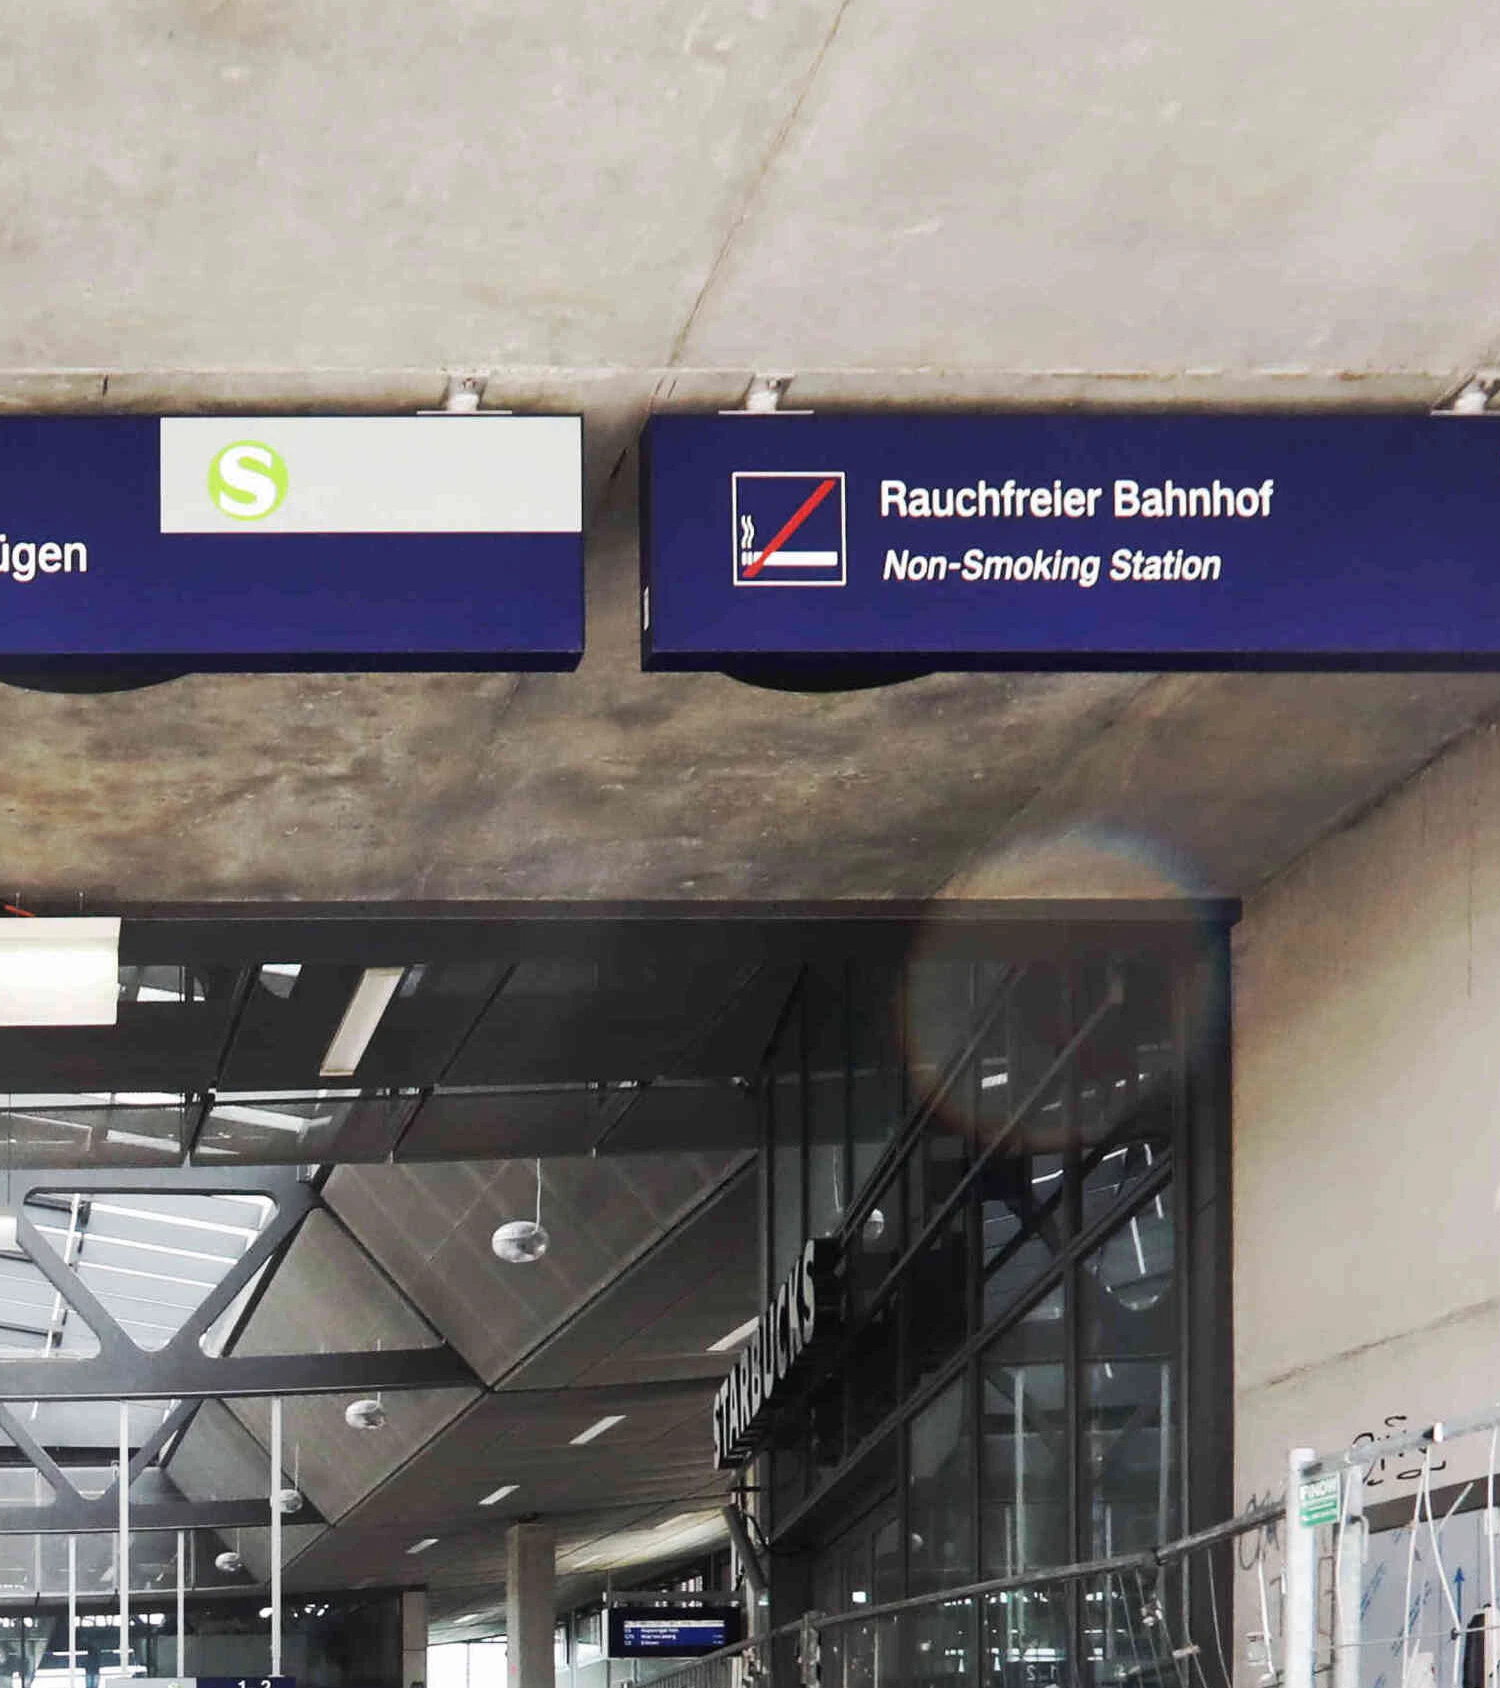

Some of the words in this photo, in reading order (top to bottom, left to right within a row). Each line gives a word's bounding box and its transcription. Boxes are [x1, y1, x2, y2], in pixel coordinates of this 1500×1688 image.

[219, 446, 276, 517] S
[880, 480, 1103, 518] Rauchfreier
[1114, 480, 1274, 518] Bahnhof
[882, 548, 1101, 588] Non-Smoking
[1109, 548, 1222, 581] Station
[713, 1239, 815, 1470] STARBUCKS
